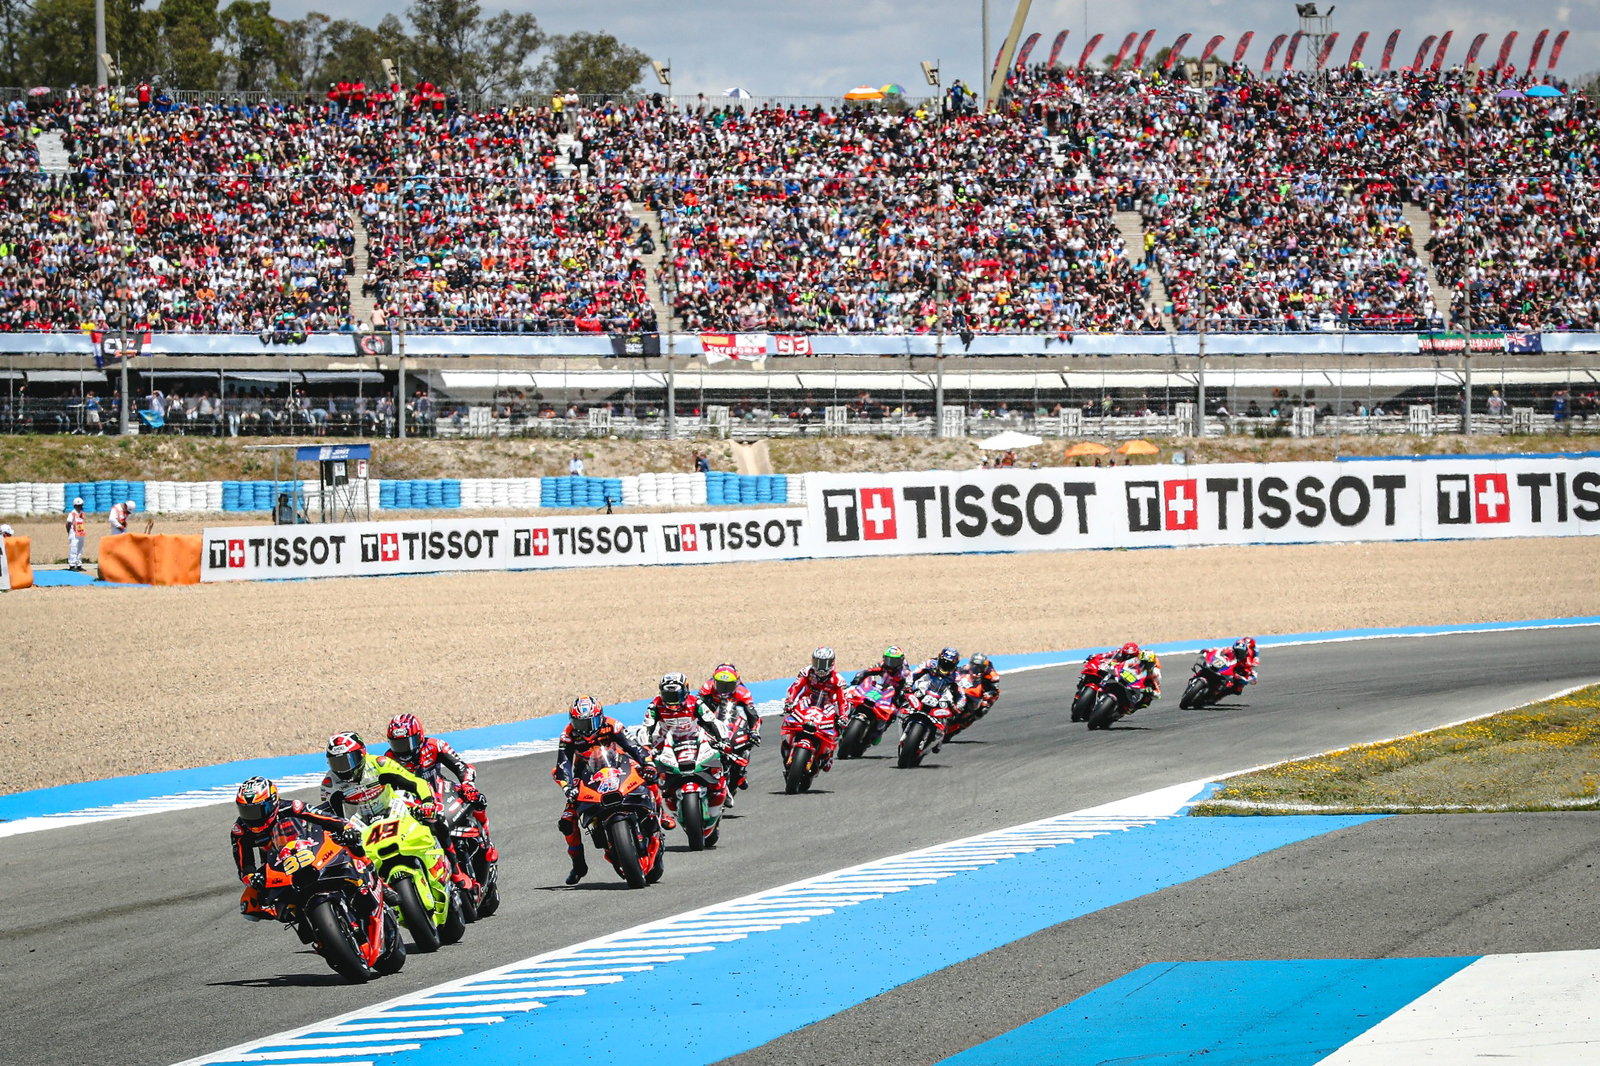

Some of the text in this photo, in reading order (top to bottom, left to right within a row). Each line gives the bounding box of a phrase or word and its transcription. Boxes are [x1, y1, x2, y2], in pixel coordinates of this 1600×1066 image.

[778, 337, 809, 355] 93
[903, 483, 1095, 538] TISSOT
[1207, 475, 1406, 530] TISSOT
[402, 529, 499, 560] TISSOT
[553, 525, 648, 555] TISSOT
[699, 519, 802, 550] TISSOT
[248, 535, 345, 567] TISSOT
[366, 819, 400, 847] 49
[283, 849, 316, 876] 33
